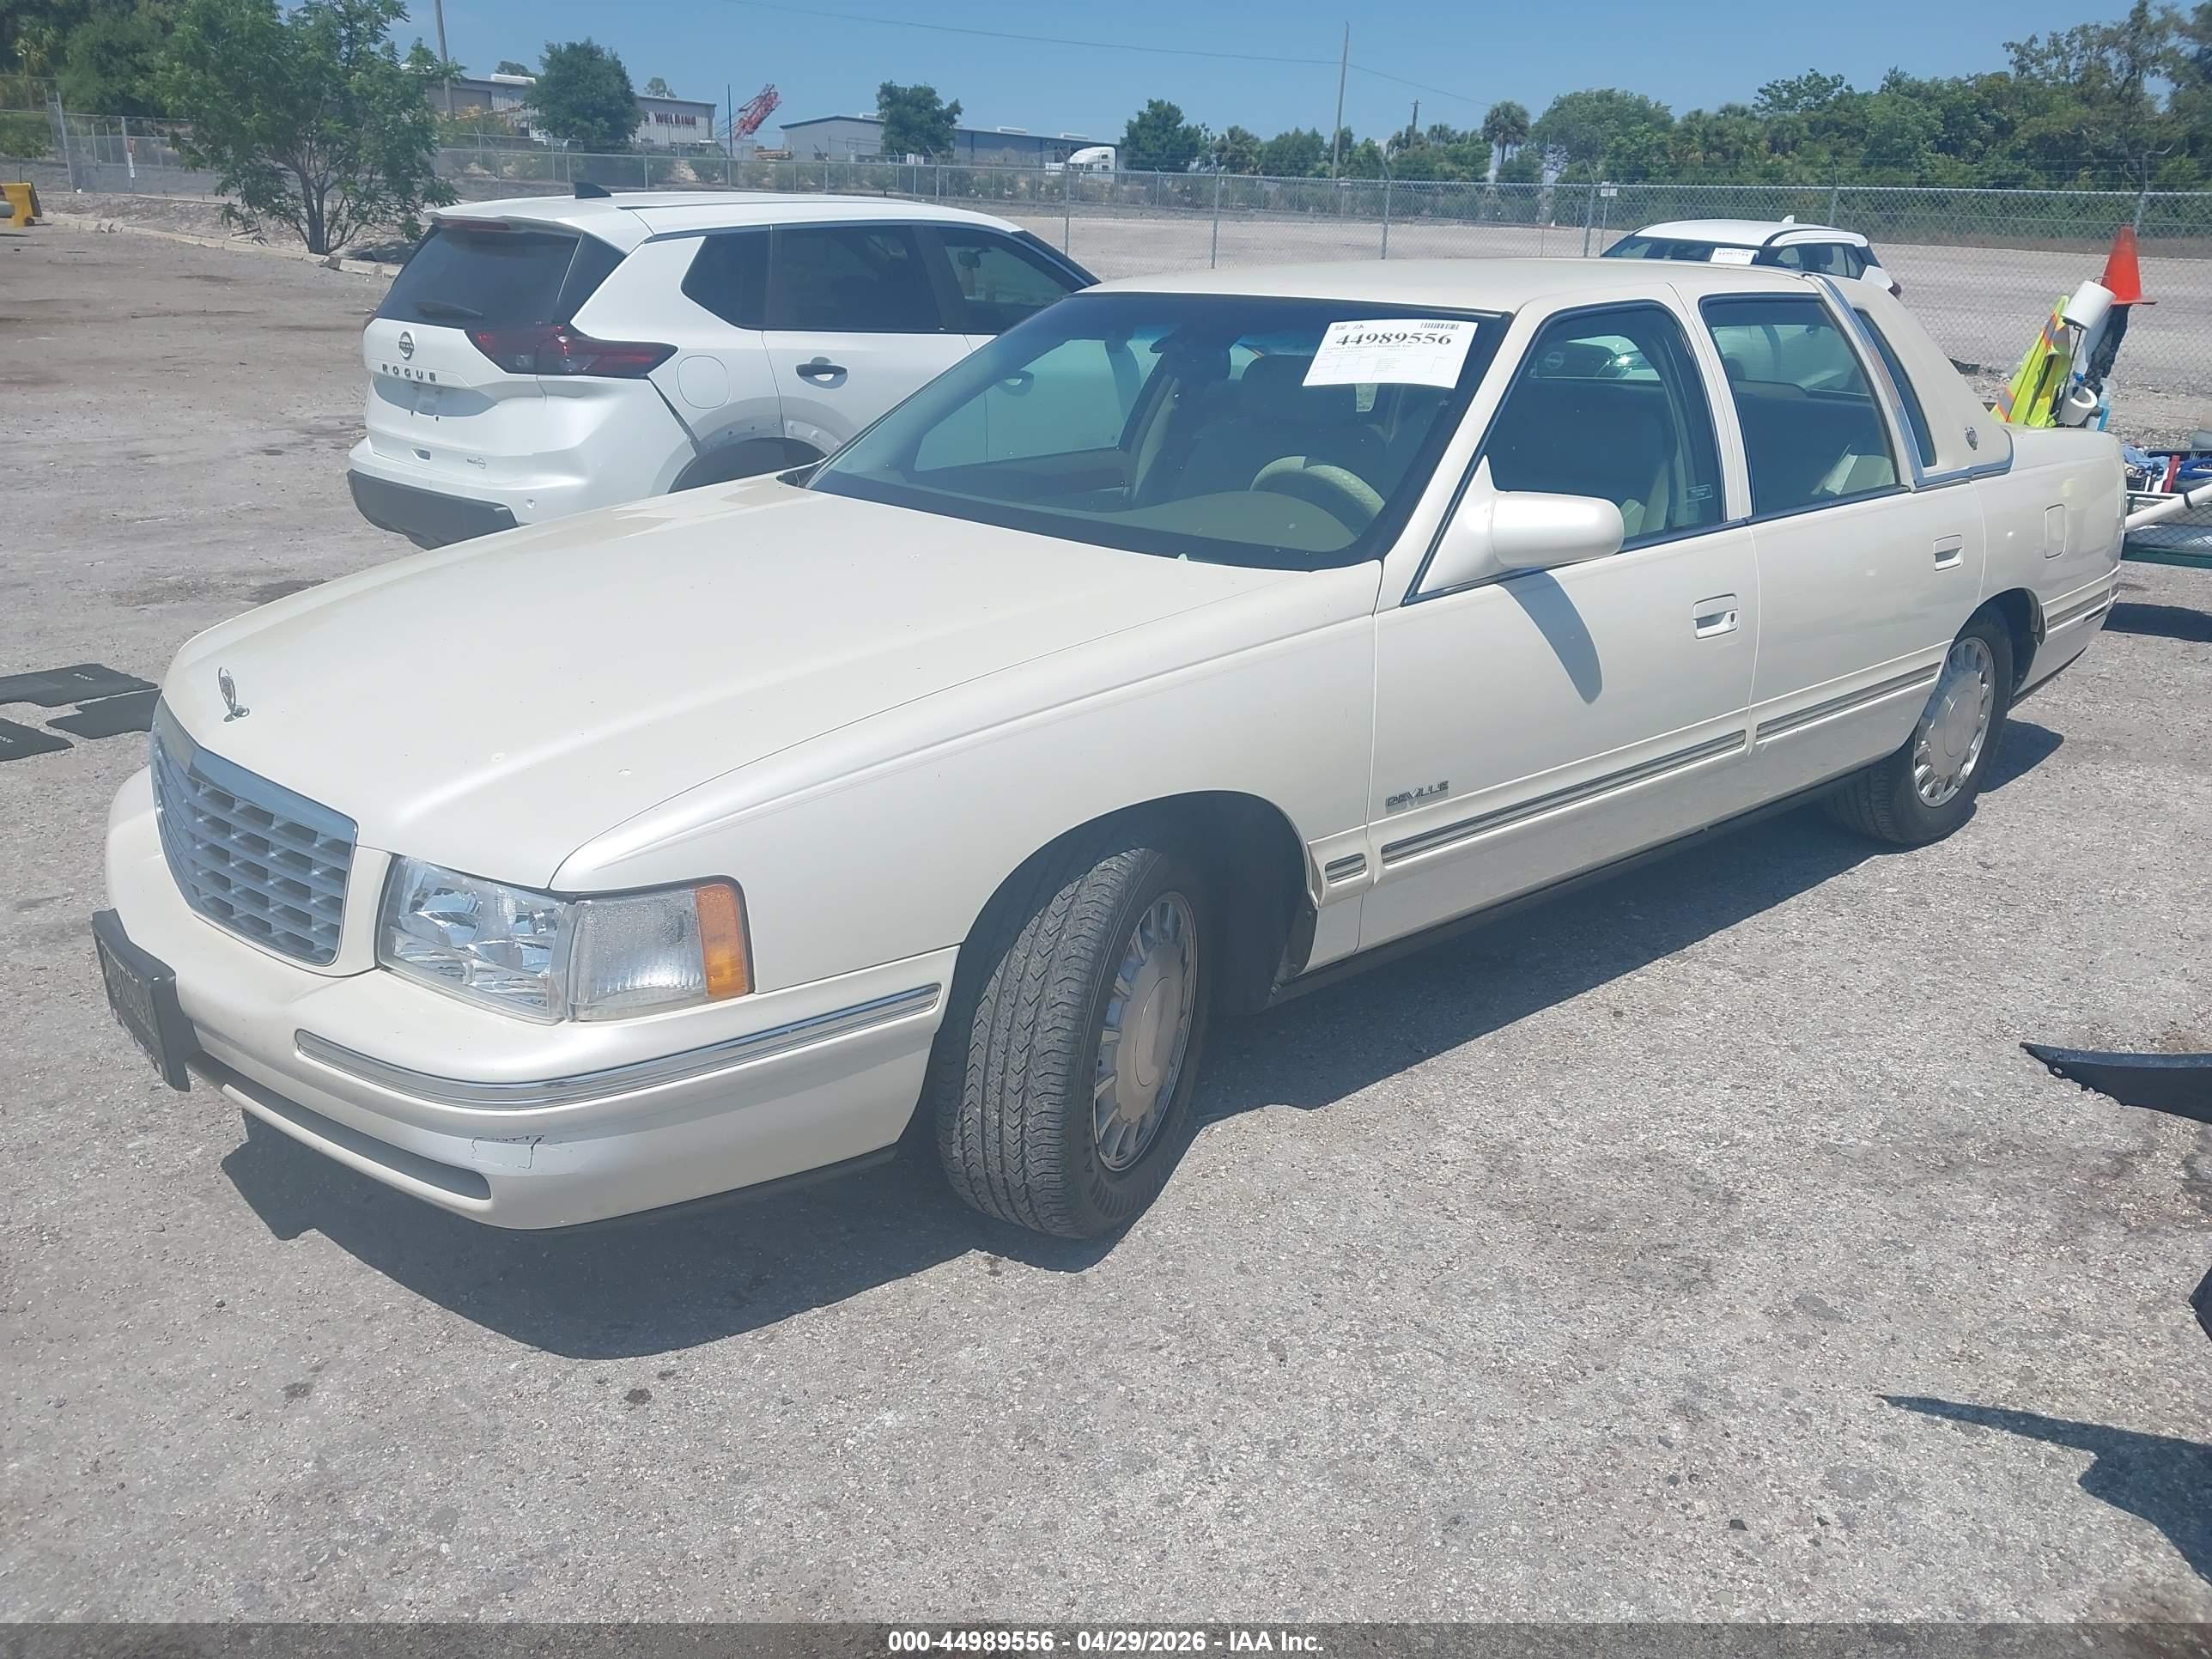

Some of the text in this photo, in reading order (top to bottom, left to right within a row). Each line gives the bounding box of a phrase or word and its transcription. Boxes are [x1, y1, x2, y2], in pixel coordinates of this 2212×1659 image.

[1335, 331, 1453, 346] 44989556
[382, 363, 436, 383] ROGUE
[1386, 781, 1449, 807] DEVILLE
